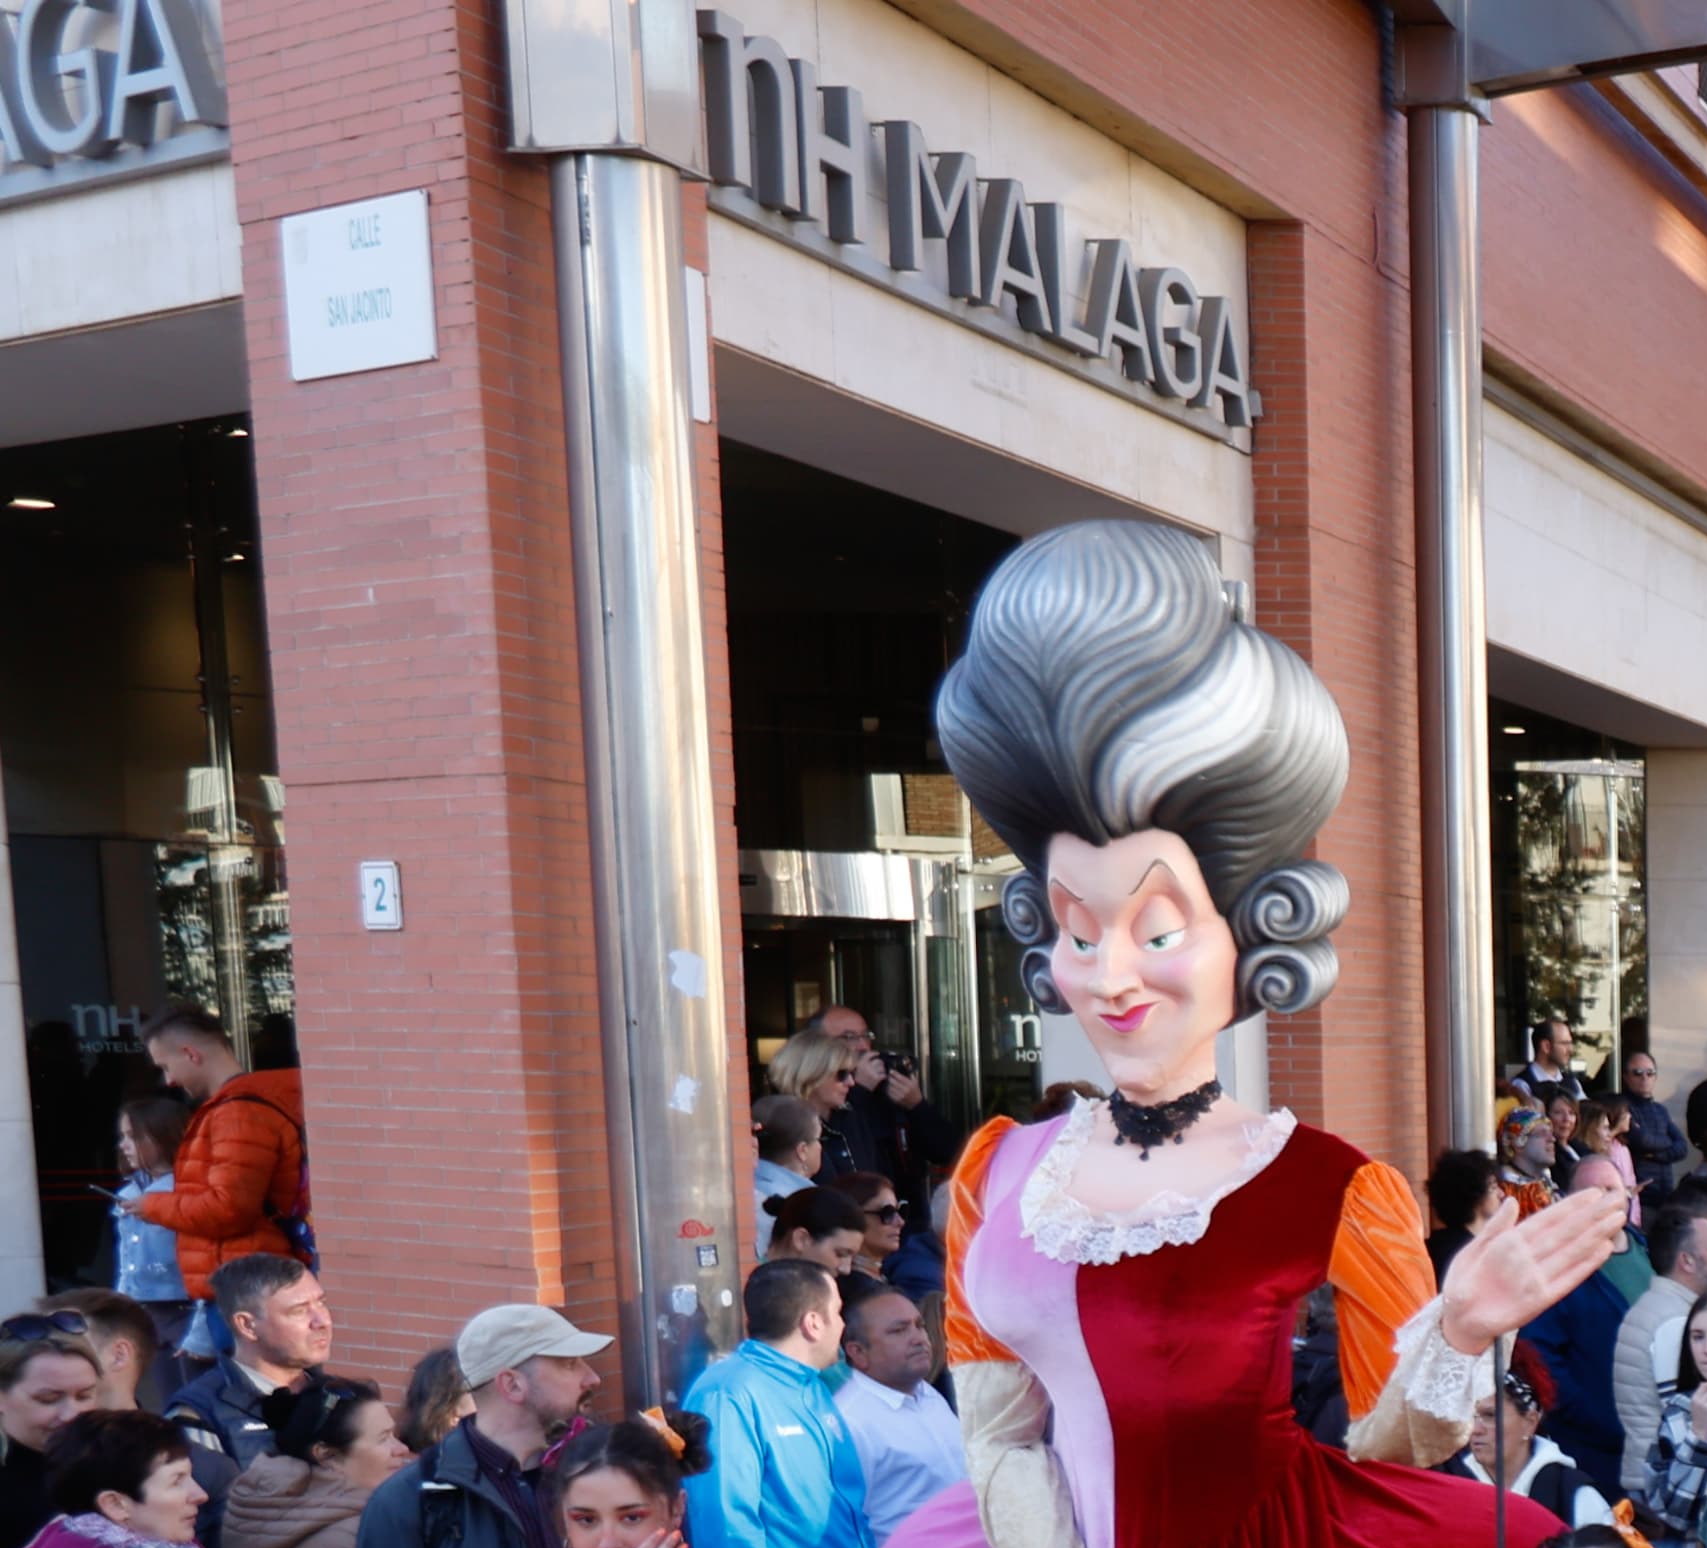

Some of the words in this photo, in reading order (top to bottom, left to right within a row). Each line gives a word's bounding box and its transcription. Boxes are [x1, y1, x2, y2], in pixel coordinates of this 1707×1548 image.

[349, 213, 382, 250] CALLE
[885, 120, 1253, 428] MALAGA
[327, 295, 349, 328] SAN
[350, 287, 393, 324] JACINTO
[373, 876, 388, 912] 2
[79, 1041, 144, 1054] HOTELS
[1016, 1050, 1042, 1063] HOT
